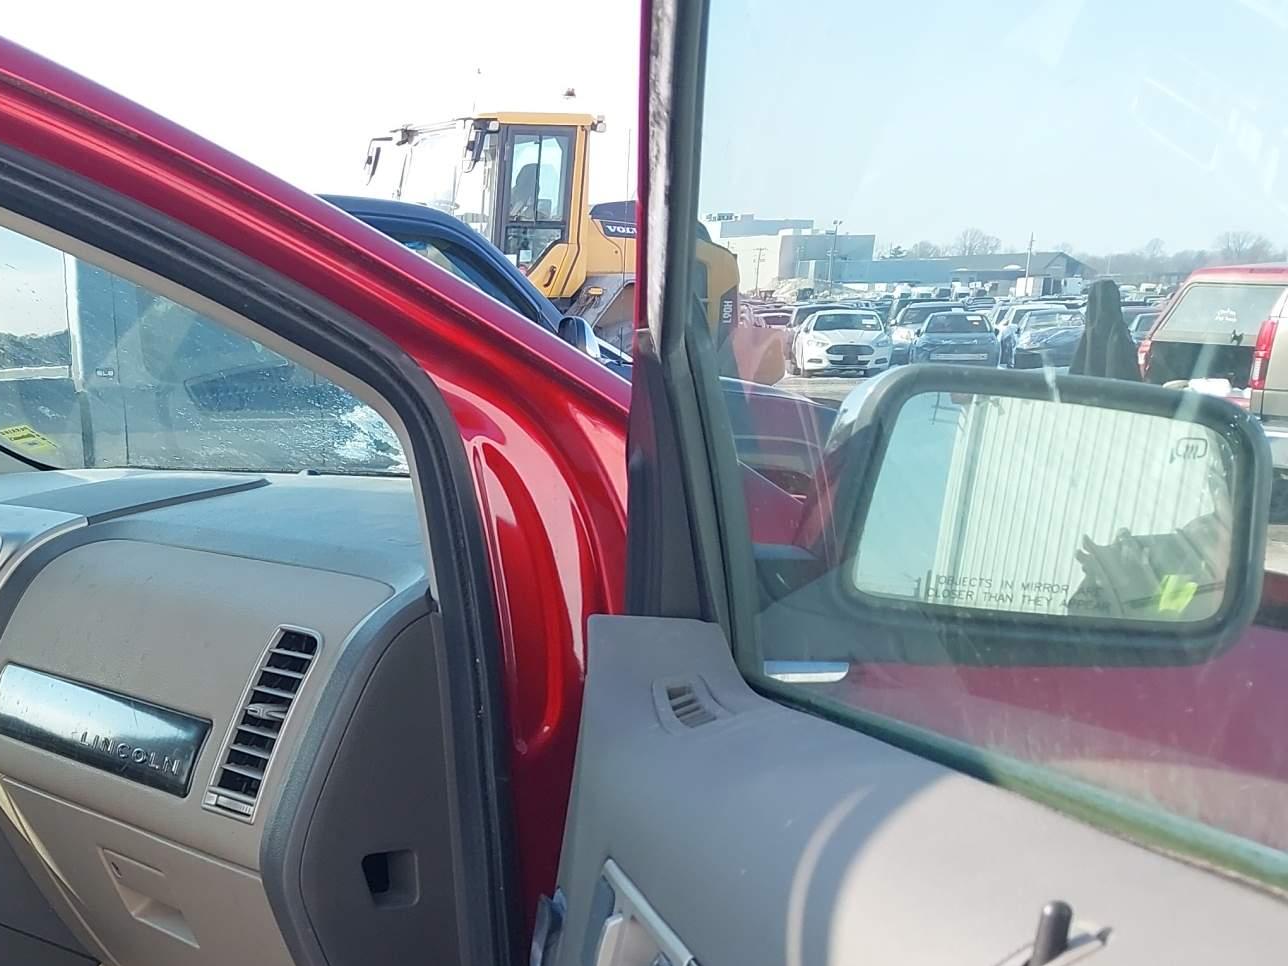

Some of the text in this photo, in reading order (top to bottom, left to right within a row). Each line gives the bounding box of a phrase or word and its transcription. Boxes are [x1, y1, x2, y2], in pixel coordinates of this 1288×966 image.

[722, 300, 733, 324] L90H
[938, 575, 993, 589] OBJECTS
[1001, 579, 1013, 590] IN
[1021, 581, 1070, 594] MIRROR
[926, 587, 974, 601] CLOSER
[983, 591, 1014, 603] THAN
[1022, 594, 1053, 607] THEY
[79, 730, 181, 775] LINCOLN
